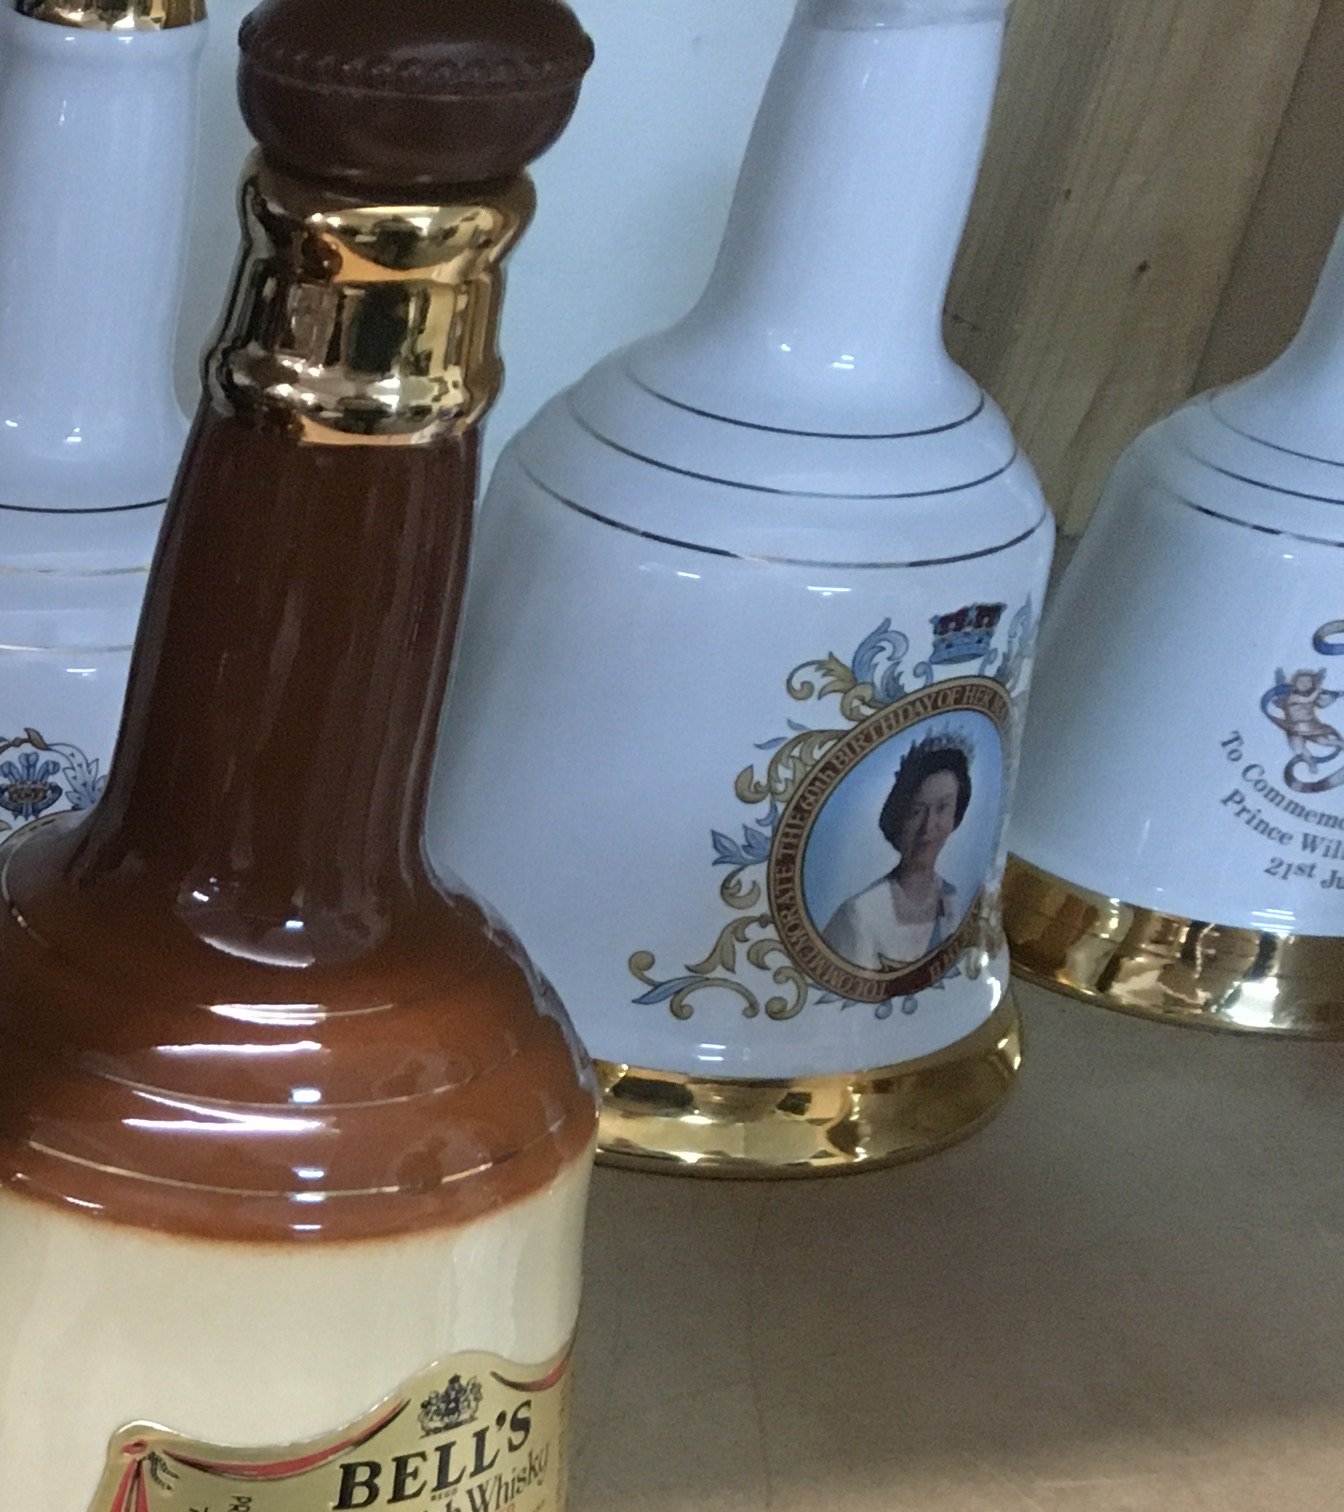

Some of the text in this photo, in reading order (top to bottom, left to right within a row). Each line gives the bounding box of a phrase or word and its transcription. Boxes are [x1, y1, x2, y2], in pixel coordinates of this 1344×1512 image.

[834, 696, 938, 766] BIRTHDAY
[1221, 730, 1244, 762] To
[1221, 788, 1293, 845] Prince
[1264, 856, 1318, 880] 21st
[332, 1399, 532, 1511] BELL'S
